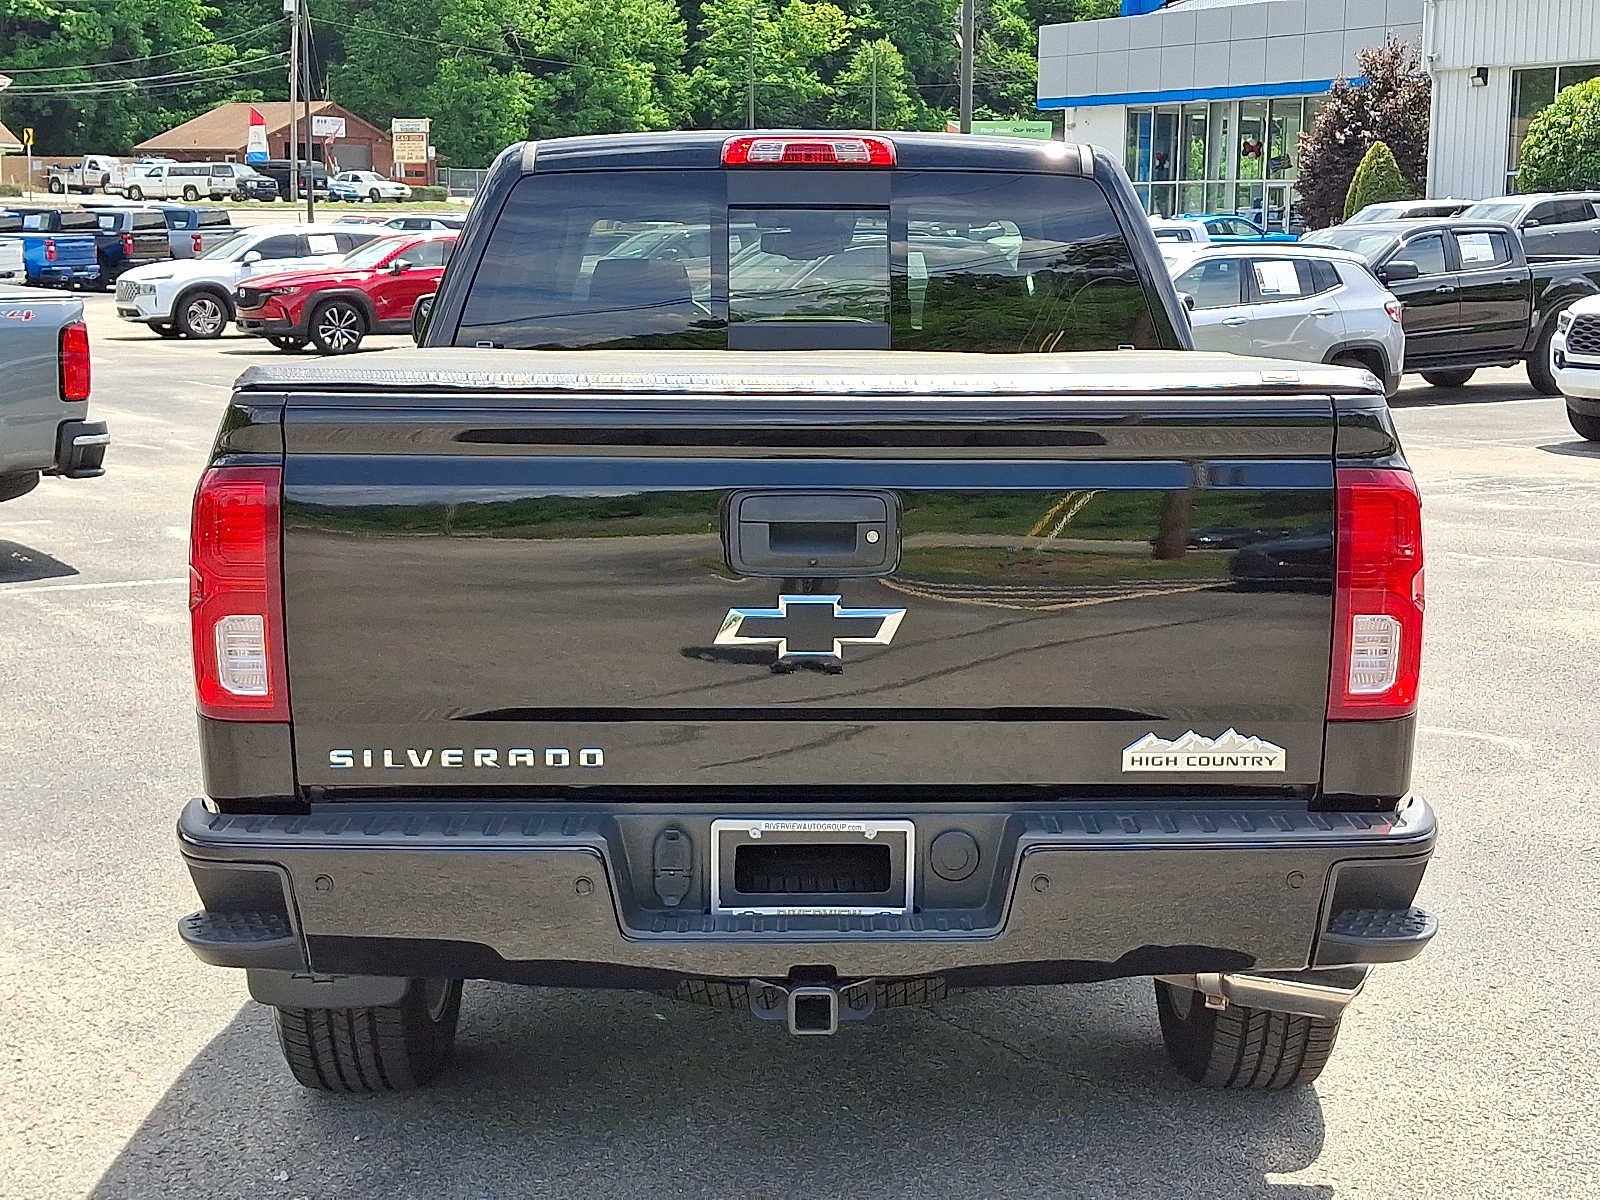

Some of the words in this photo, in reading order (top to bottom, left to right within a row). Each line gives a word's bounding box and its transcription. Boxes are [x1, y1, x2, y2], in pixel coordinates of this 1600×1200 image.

[329, 748, 605, 768] SILVERADO
[1131, 756, 1177, 767] HIGH
[1186, 756, 1278, 767] COUNTRY
[764, 823, 862, 831] RIVERVIEWAUTOGROUP.com
